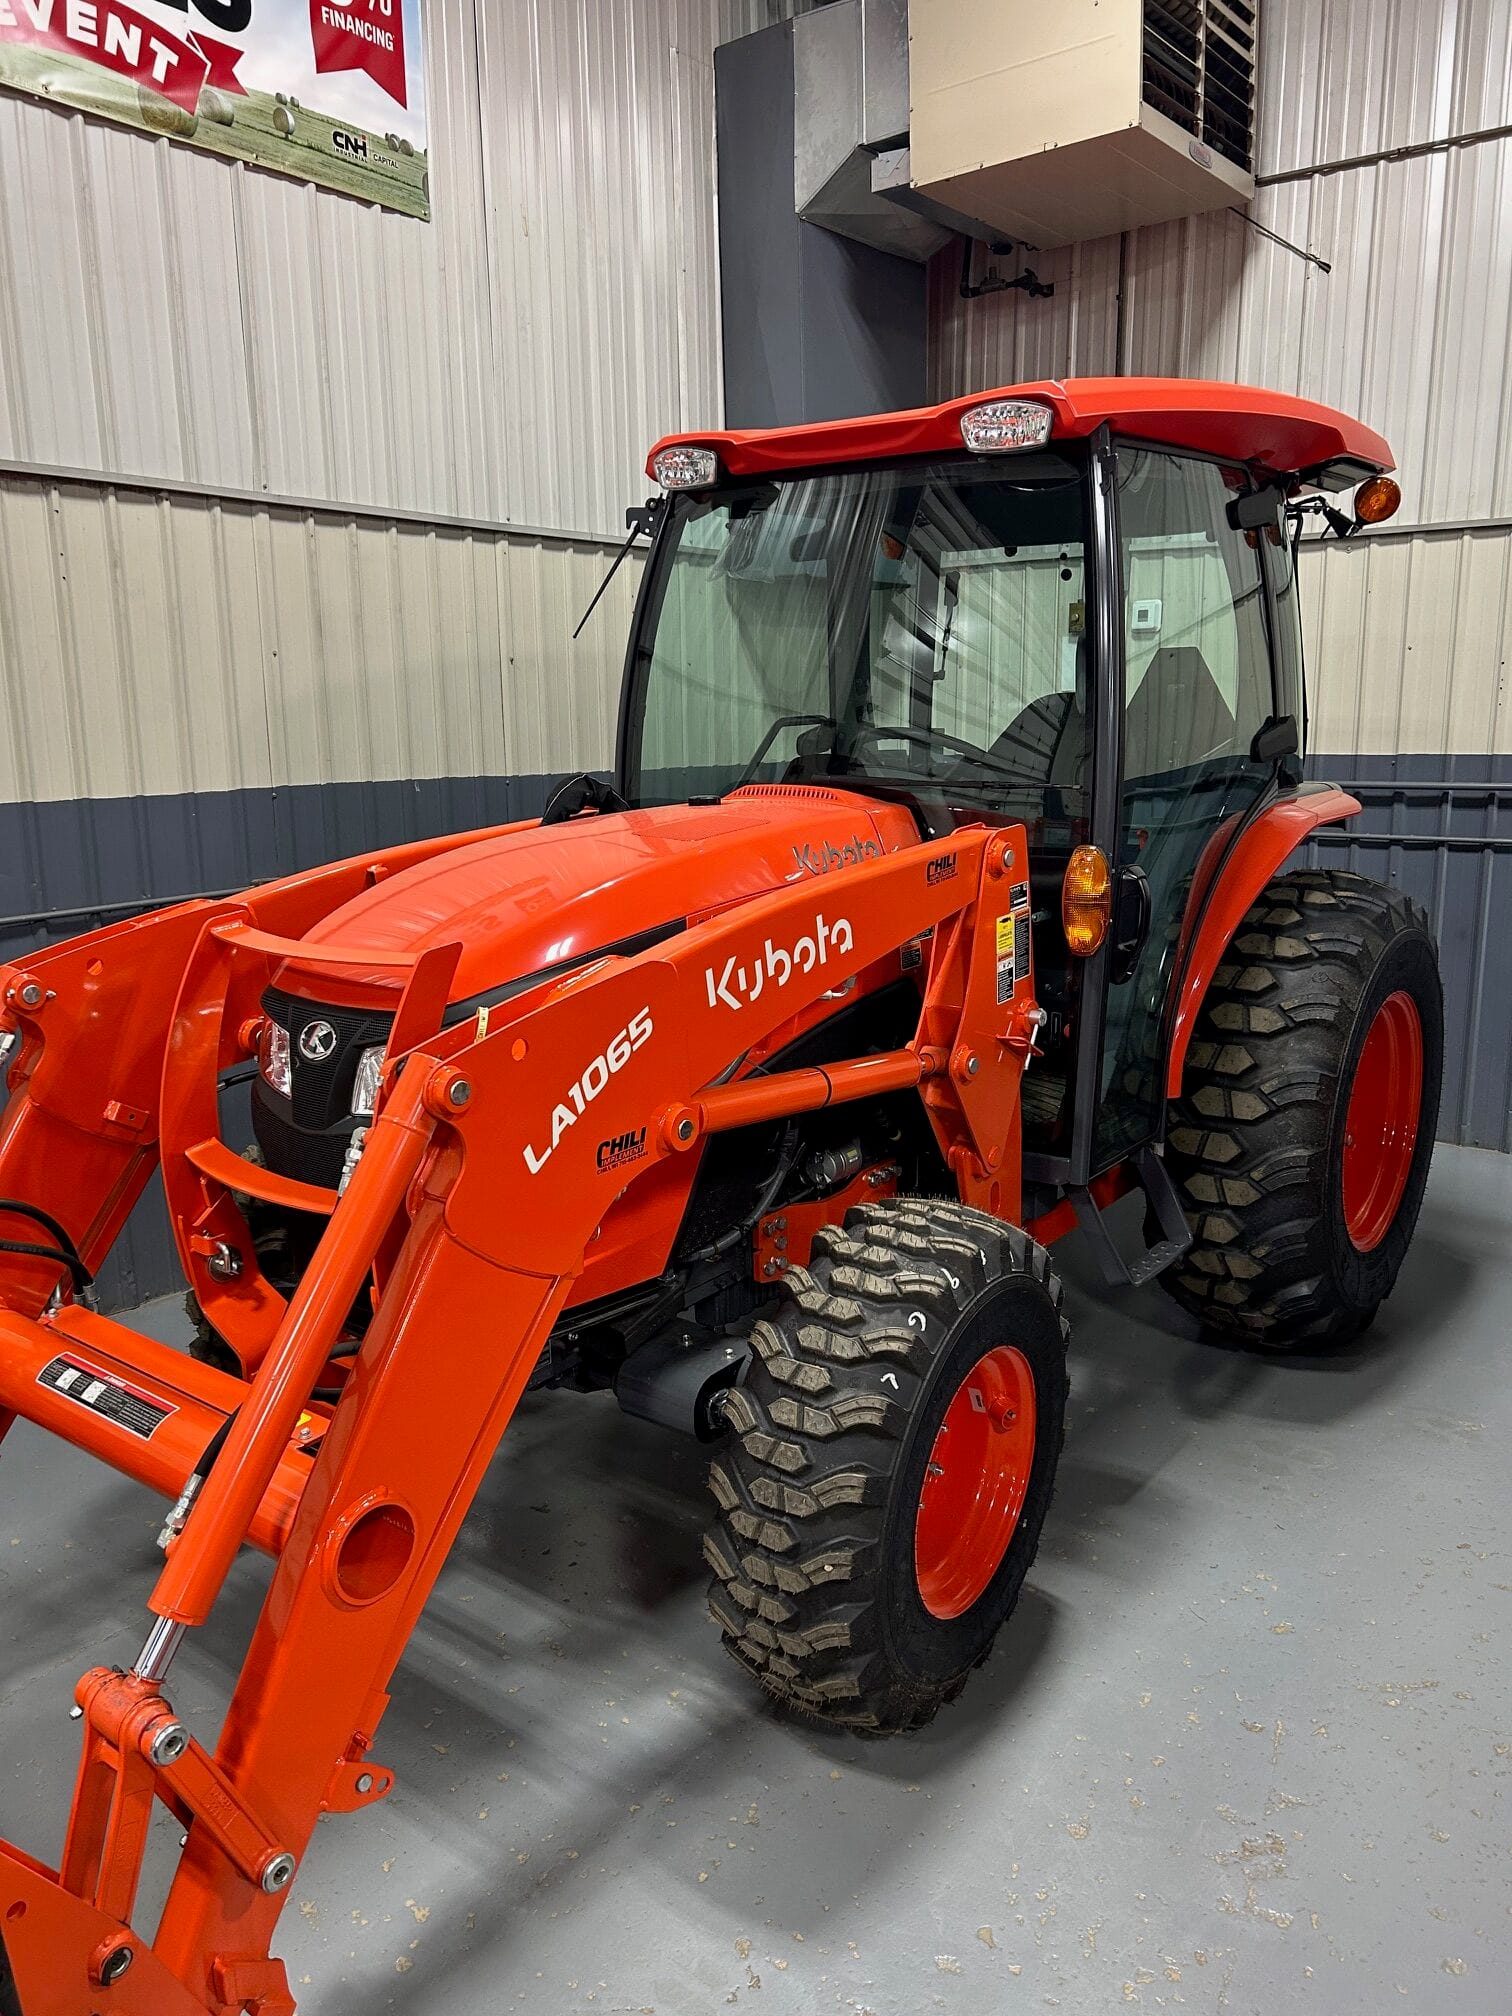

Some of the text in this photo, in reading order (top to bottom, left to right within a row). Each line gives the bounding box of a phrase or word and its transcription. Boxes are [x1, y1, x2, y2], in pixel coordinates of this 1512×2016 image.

[373, 154, 399, 169] CAPITAL
[792, 835, 880, 875] Kubota
[926, 852, 957, 882] CHILI
[704, 913, 854, 1011] Kubota
[522, 1006, 654, 1174] LA1065
[597, 1127, 647, 1168] CHILI
[602, 1145, 643, 1167] IMPLEMENT
